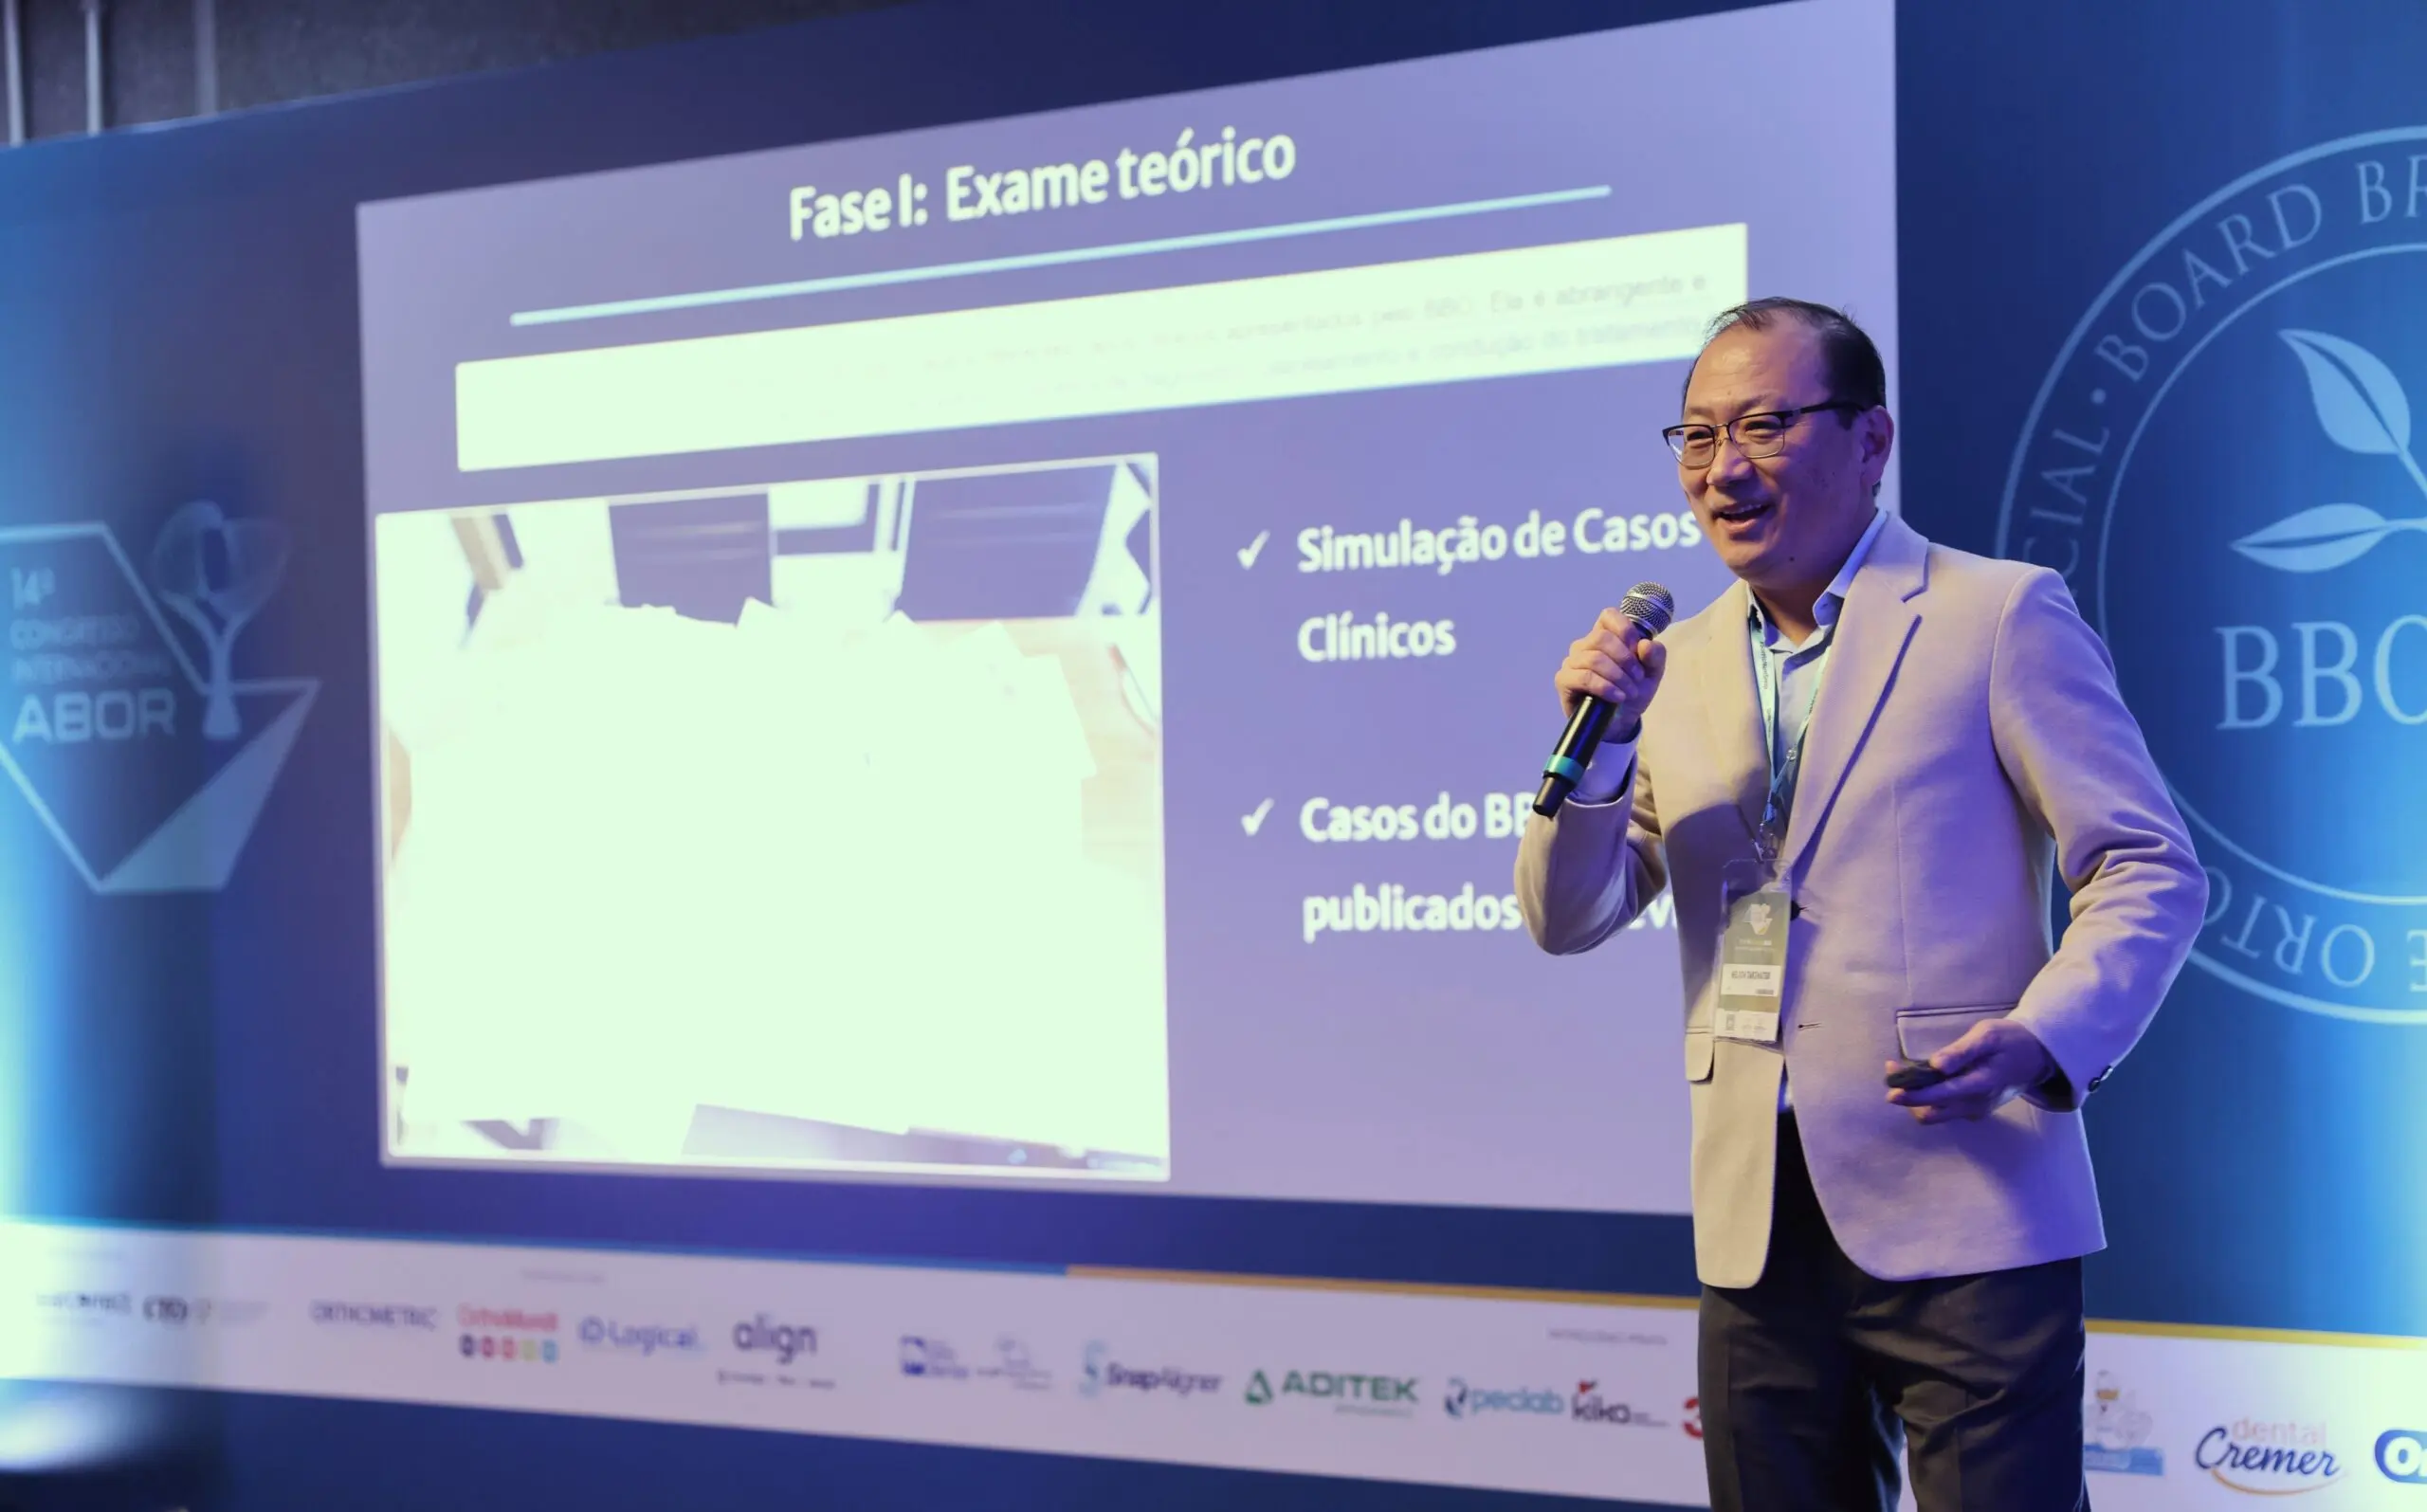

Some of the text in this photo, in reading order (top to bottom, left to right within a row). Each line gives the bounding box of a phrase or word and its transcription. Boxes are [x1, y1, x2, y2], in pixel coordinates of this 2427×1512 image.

[790, 125, 1296, 241] Fase I: Exame teórico
[2093, 183, 2323, 382] BOARD
[1297, 508, 1703, 575] Simulação de Casos
[1297, 610, 1456, 663] Clínicos
[12, 688, 176, 744] ABOR
[1300, 796, 1419, 843] Casos
[1424, 791, 1478, 839] do
[1302, 883, 1523, 945] publicados
[733, 1311, 818, 1365] align
[1283, 1369, 1420, 1403] ADITEK
[2195, 1426, 2341, 1477] Cremer
[2232, 1417, 2327, 1446] dental
